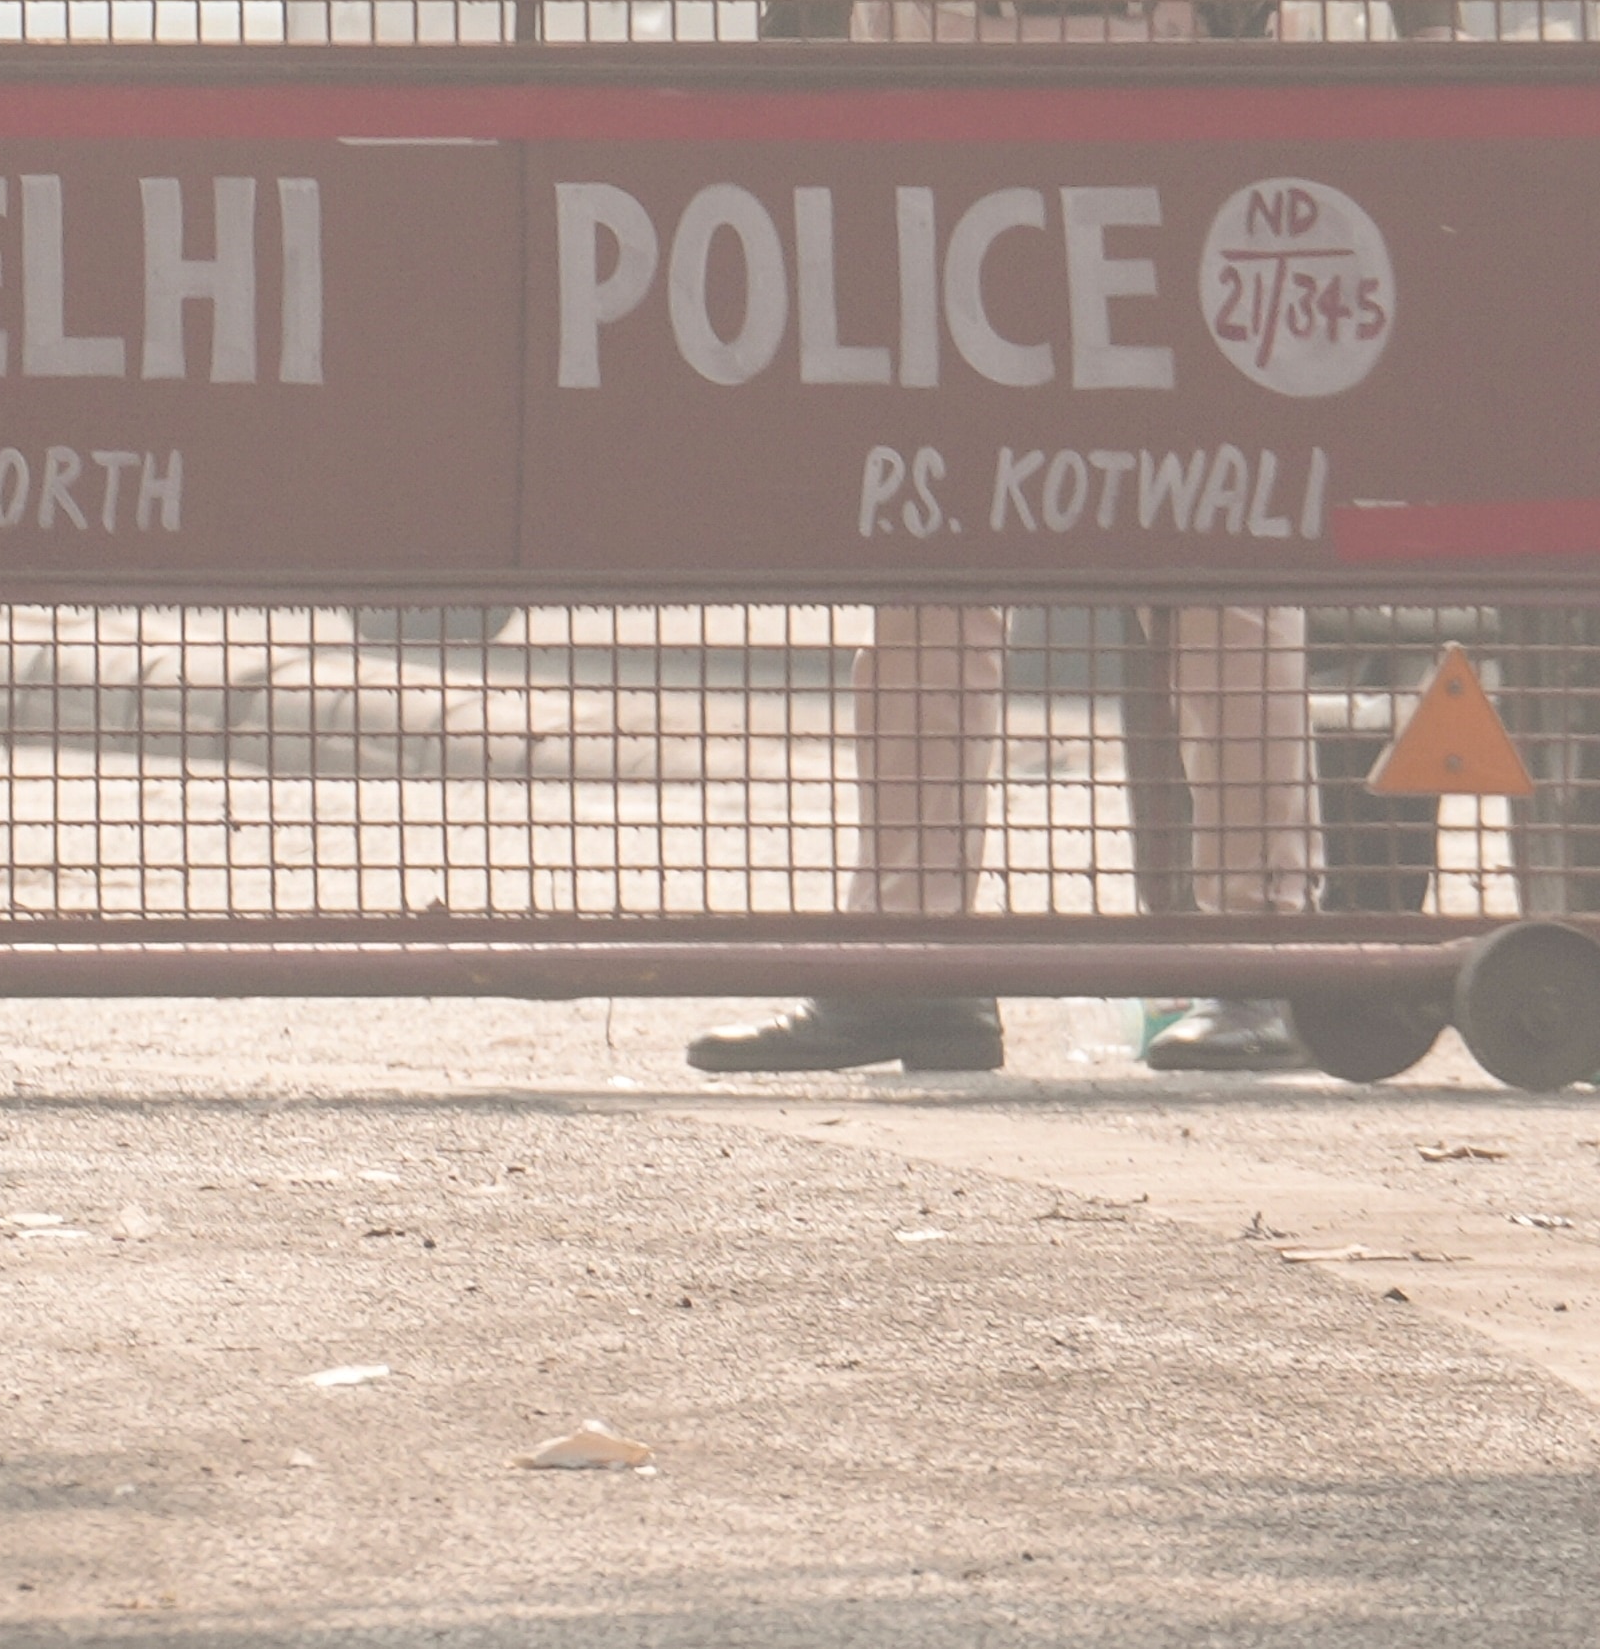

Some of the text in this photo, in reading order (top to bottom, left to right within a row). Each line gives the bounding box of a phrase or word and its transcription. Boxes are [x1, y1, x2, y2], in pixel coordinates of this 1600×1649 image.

[1246, 188, 1319, 238] ND
[553, 181, 1176, 389] POLICE
[1214, 257, 1386, 369] 21/345
[859, 443, 1327, 539] P.S. KOTWALI
